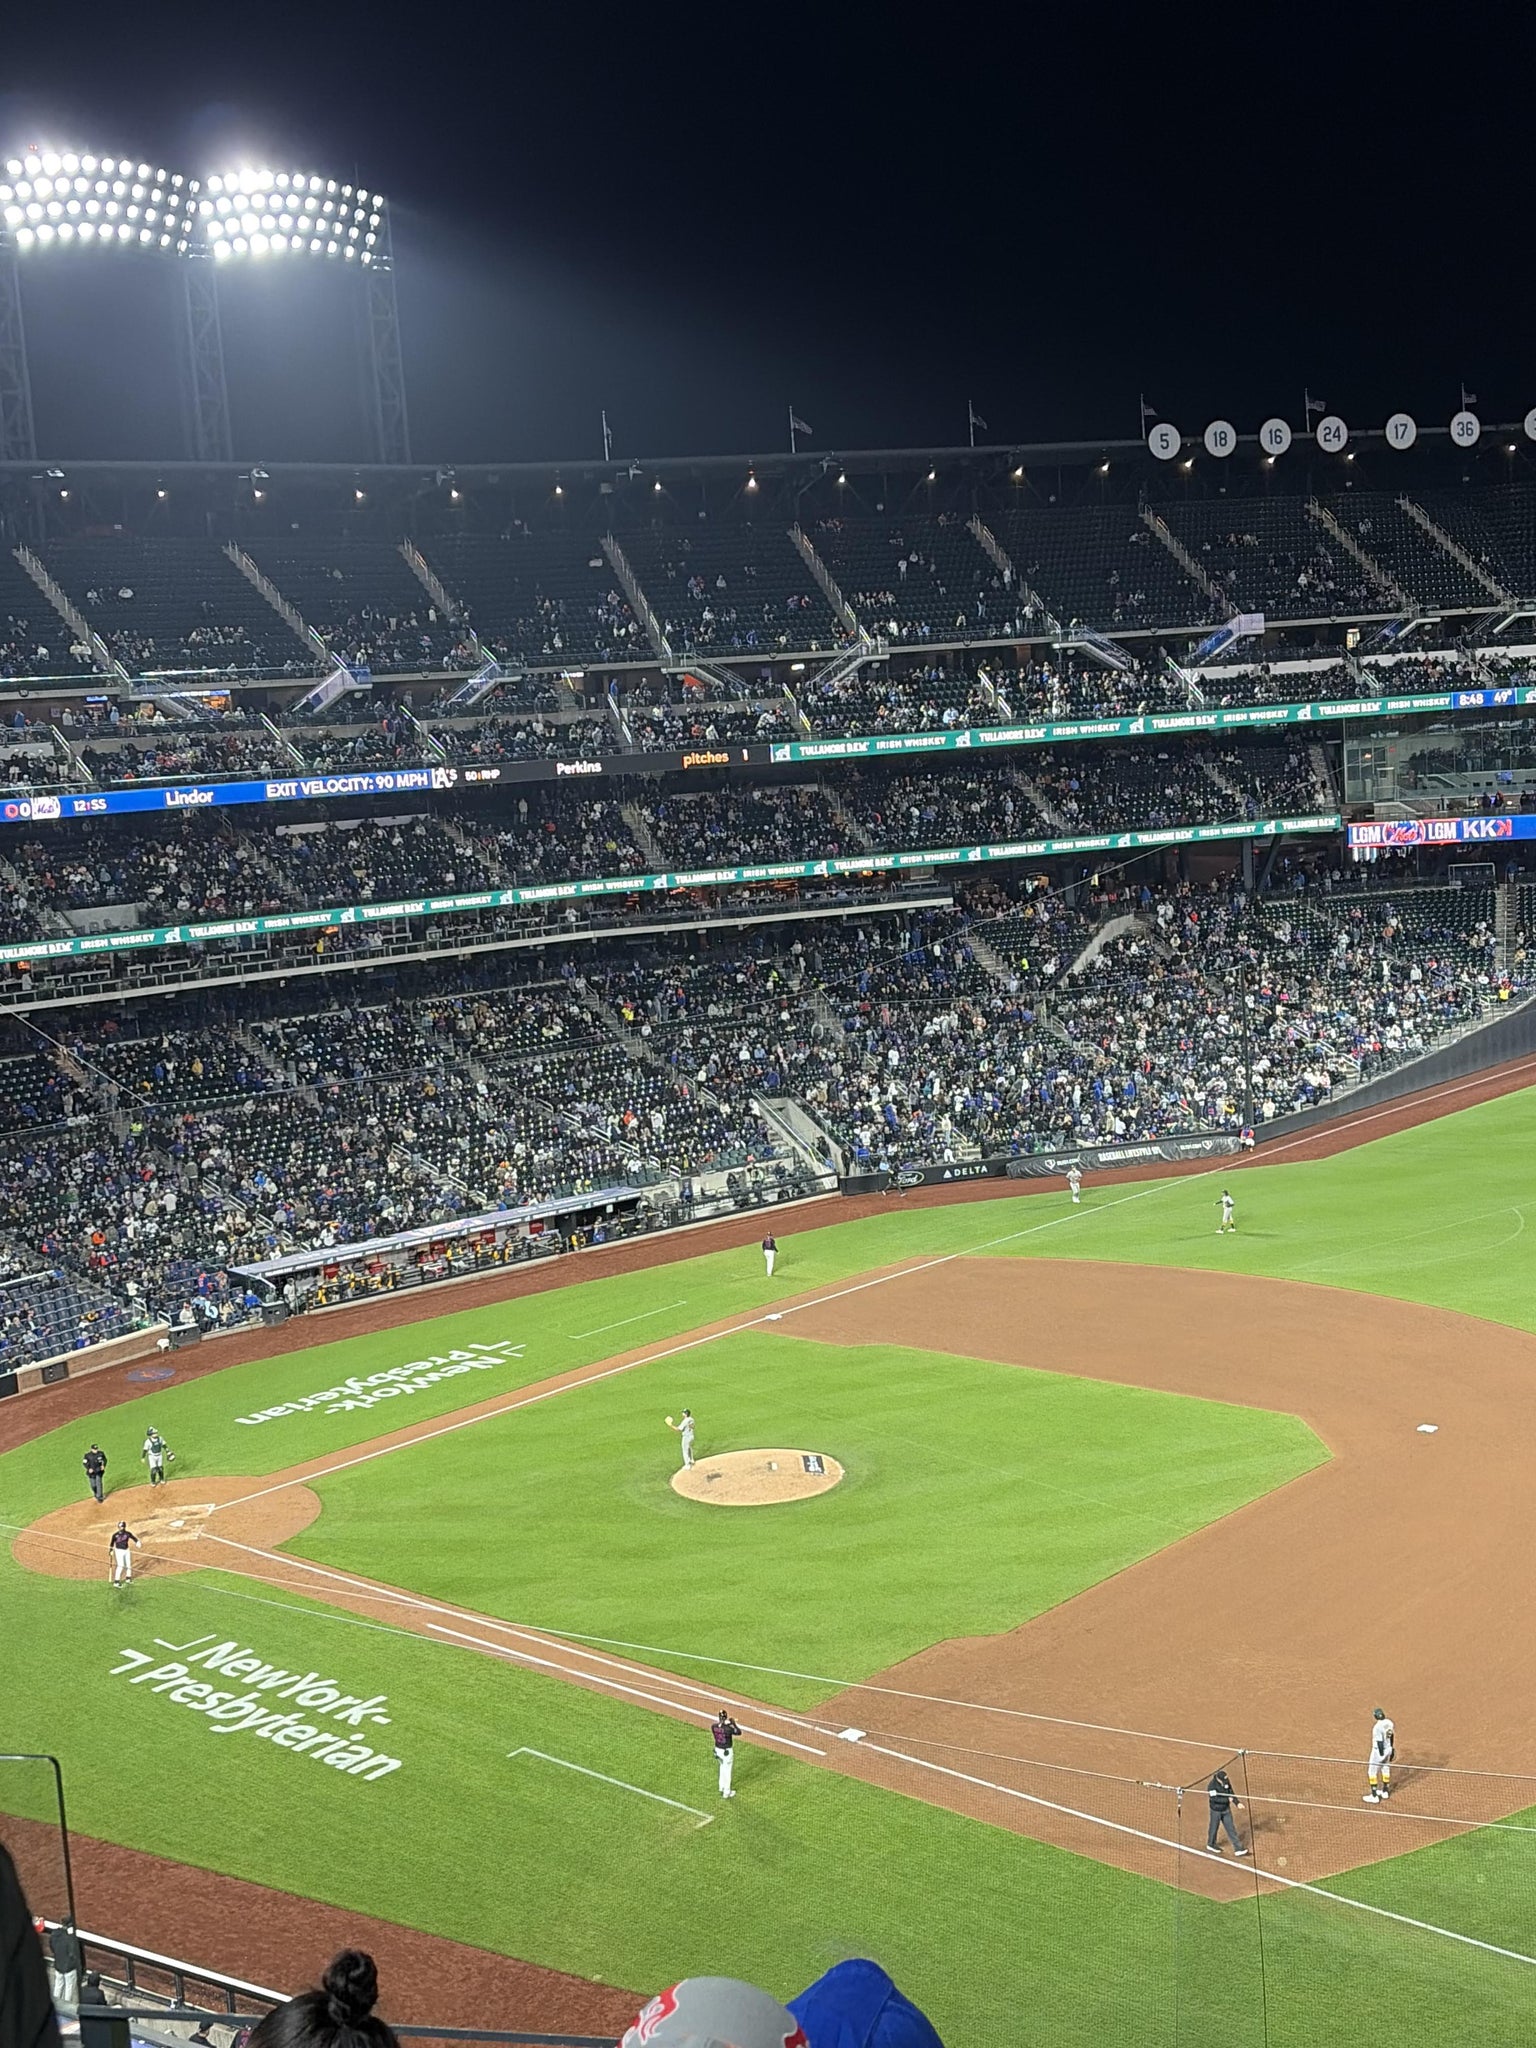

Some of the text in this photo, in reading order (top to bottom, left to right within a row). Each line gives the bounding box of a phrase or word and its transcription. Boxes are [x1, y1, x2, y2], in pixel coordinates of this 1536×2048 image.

[1269, 427, 1283, 445] 16
[1323, 425, 1341, 443] 24
[1394, 423, 1408, 440] 17
[1456, 420, 1474, 437] 36
[1160, 433, 1169, 450] 5
[1213, 430, 1227, 447] 18
[1388, 700, 1411, 710] IRISH
[1413, 697, 1450, 708] WHISKEY
[1459, 693, 1484, 706] 8:48
[1223, 713, 1247, 723] IRISH
[1250, 709, 1289, 720] WHISKEY
[1053, 726, 1078, 736] IRISH
[1081, 723, 1121, 734] WHISKEY
[876, 739, 902, 750] IRISH
[904, 736, 946, 747] WHISKEY
[556, 760, 602, 775] Perkins
[683, 750, 729, 769] pitches
[266, 772, 428, 798] EXIT VELOCITY: 90 MPH
[165, 788, 214, 806] Lindor
[1199, 828, 1220, 837] IRISH
[1222, 825, 1257, 835] WHISKEY
[1352, 826, 1381, 843] LGM
[1428, 821, 1457, 840] LGM
[1052, 841, 1074, 850] IRISH
[1076, 838, 1111, 848] WHISKEY
[900, 855, 922, 864] IRISH
[925, 851, 961, 862] WHISKEY
[743, 868, 766, 878] IRISH
[769, 865, 806, 876] WHISKEY
[582, 883, 605, 892] IRISH
[608, 879, 645, 890] WHISKEY
[431, 899, 453, 910] IRISH
[455, 895, 491, 907] WHISKEY
[265, 918, 289, 928] IRISH
[292, 913, 332, 925] WHISKEY
[81, 938, 108, 949] IRISH
[111, 933, 155, 946] WHISKEY
[954, 1165, 988, 1177] DELTA
[234, 1350, 477, 1425] Presbyterian
[129, 1662, 403, 1781] Presbyterian
